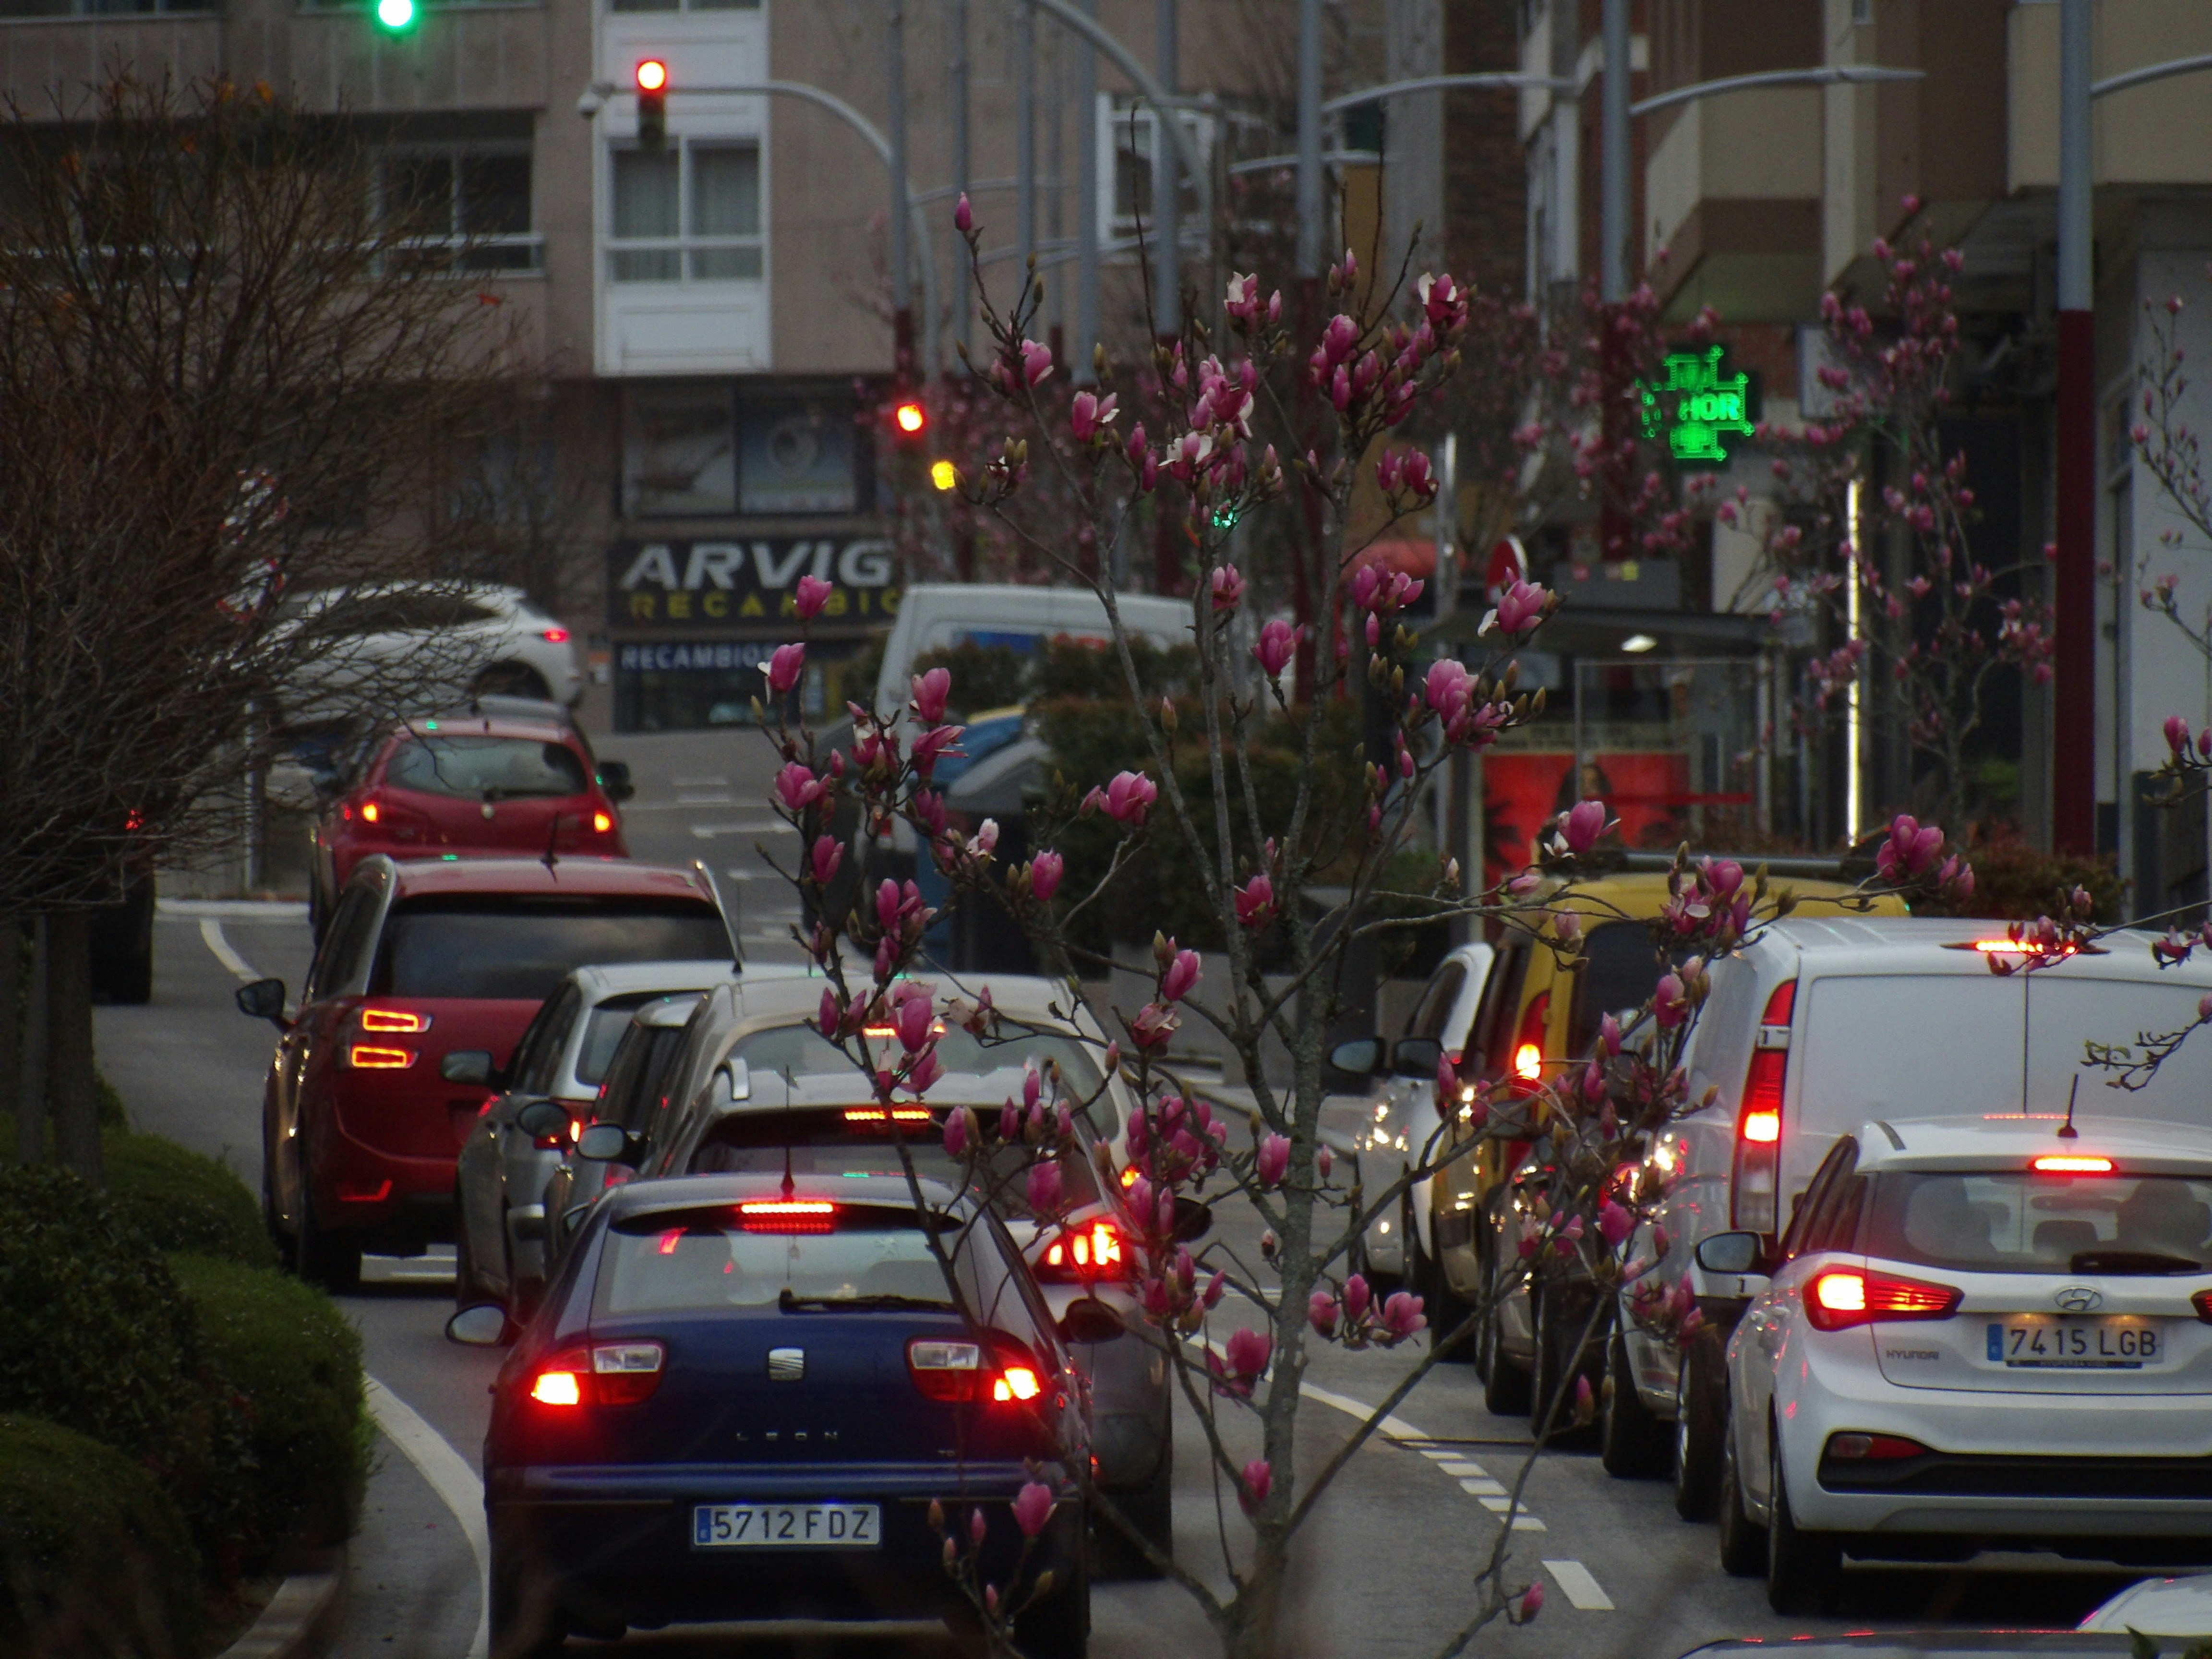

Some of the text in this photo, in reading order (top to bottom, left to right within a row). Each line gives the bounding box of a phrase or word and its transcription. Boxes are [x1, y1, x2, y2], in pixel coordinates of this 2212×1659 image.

[620, 541, 893, 590] ARVIG
[1886, 1349, 1939, 1360] HYUNDAI
[2010, 1328, 2157, 1357] 7415 LGB
[714, 1510, 869, 1539] 5712 FDZ
